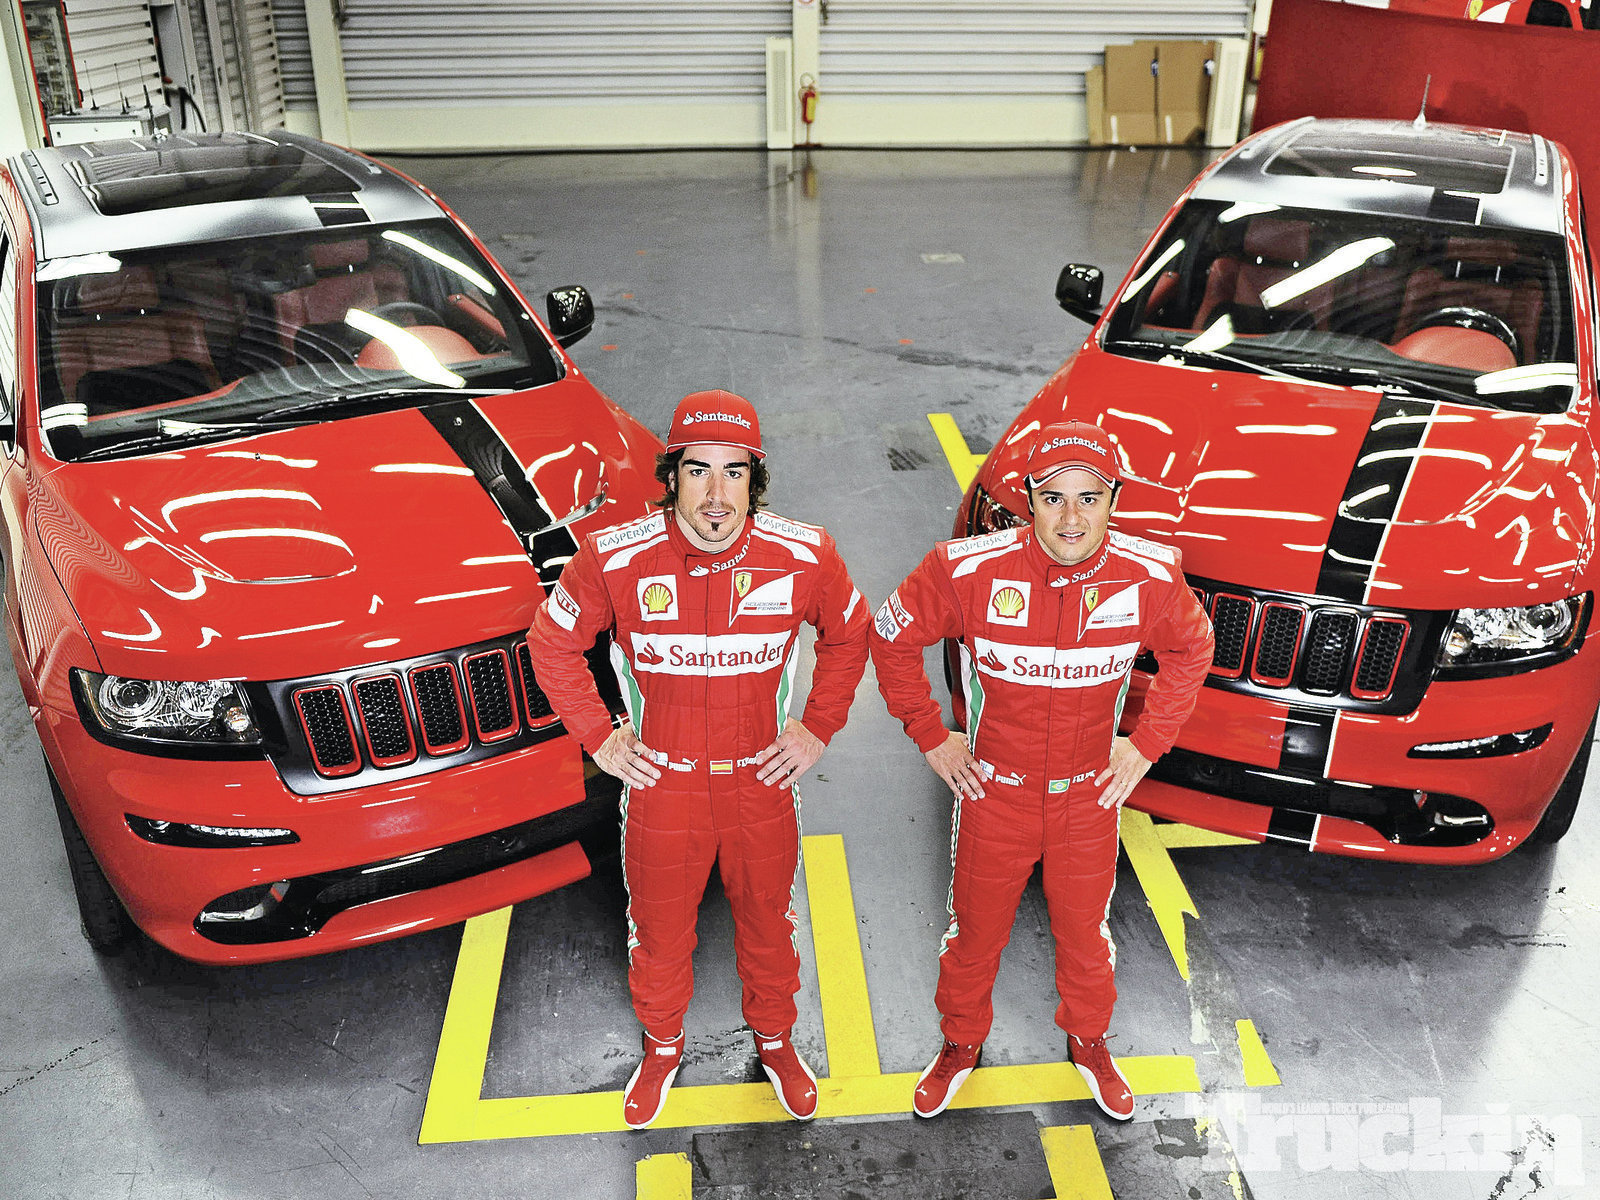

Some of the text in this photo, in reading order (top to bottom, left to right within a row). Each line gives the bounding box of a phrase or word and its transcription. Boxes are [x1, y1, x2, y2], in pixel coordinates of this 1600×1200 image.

[695, 411, 751, 430] Santander
[1052, 436, 1107, 457] Santander
[599, 521, 657, 548] KASPERSKY
[756, 514, 812, 537] KASPERSKY
[949, 533, 1009, 555] KASPERSKY
[669, 642, 783, 668] Santander
[1013, 655, 1133, 681] Santander
[995, 774, 1019, 787] PUMA
